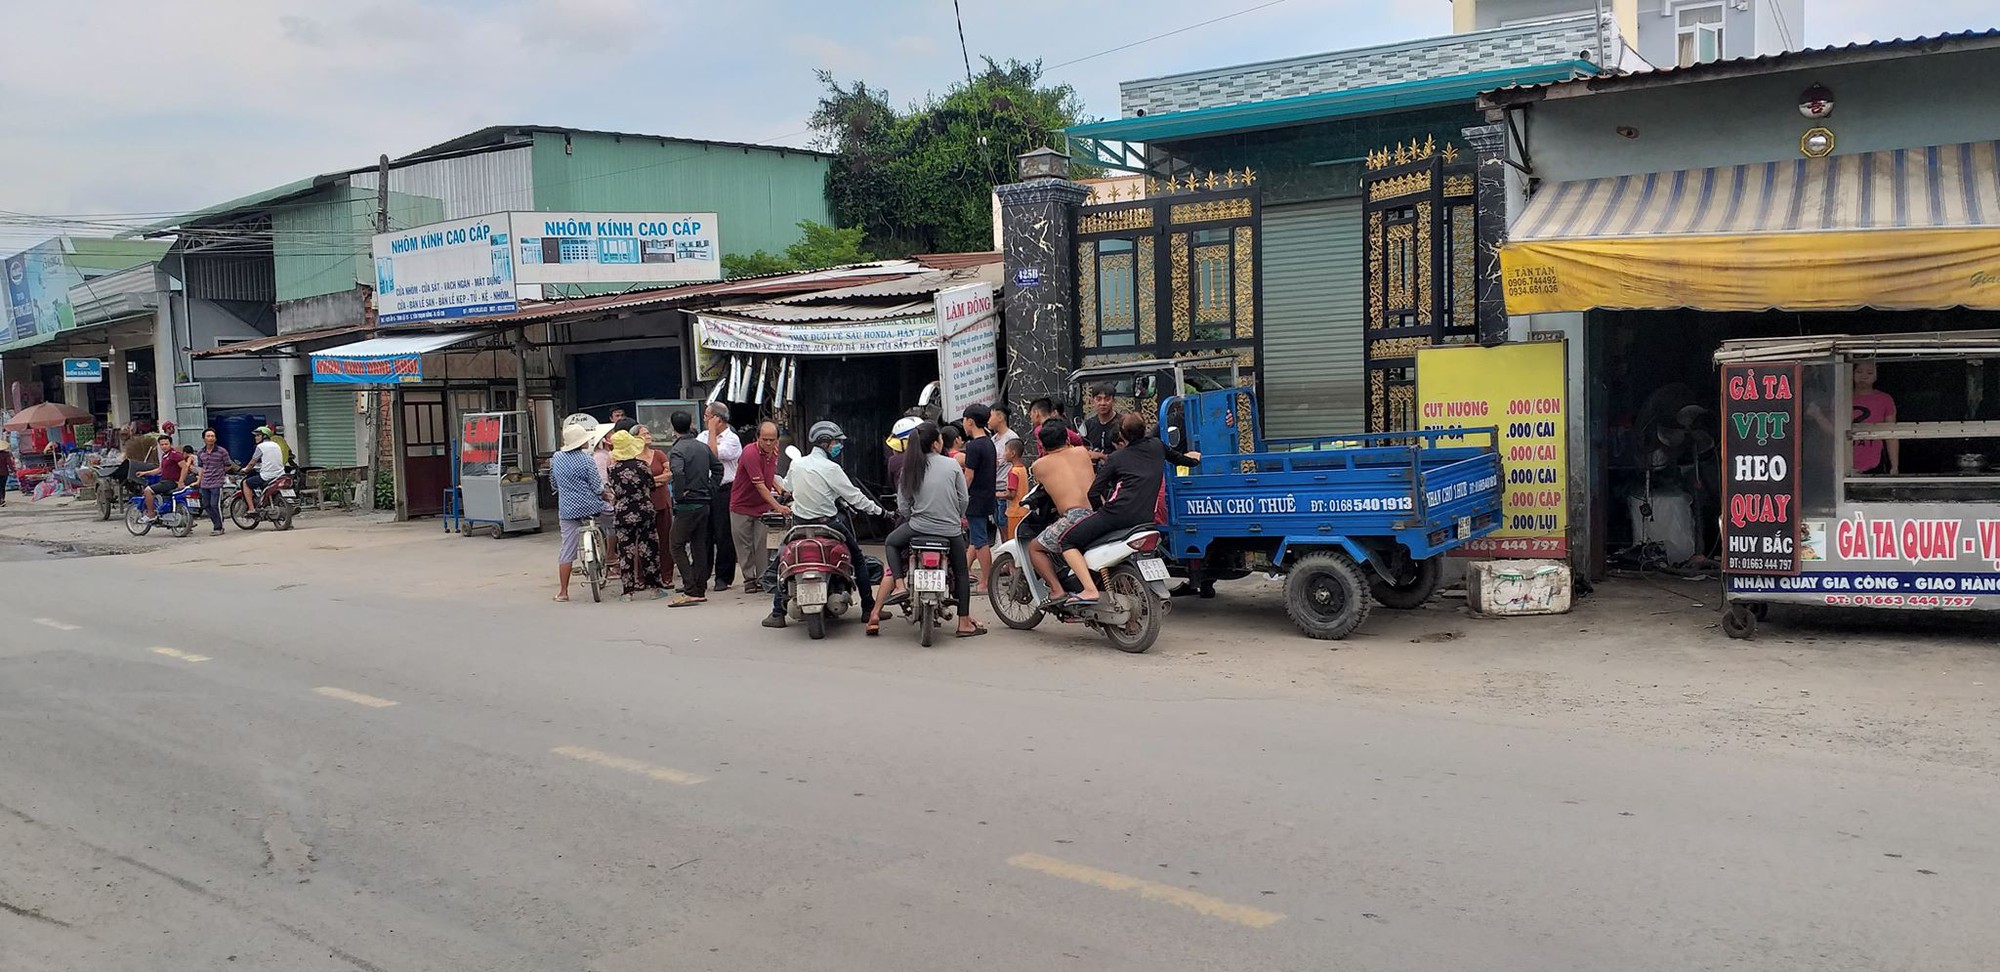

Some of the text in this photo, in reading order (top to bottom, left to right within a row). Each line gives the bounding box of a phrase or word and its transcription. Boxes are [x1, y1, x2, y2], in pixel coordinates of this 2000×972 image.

[545, 217, 701, 236] NHÔM KÍNH CAO CẤP
[392, 220, 490, 254] NHÔM KÍNH CAO CẤP
[1509, 285, 1558, 296] 0934.651.036
[946, 292, 990, 320] LÀM ĐỒNG
[845, 330, 861, 339] SAU
[1730, 369, 1792, 400] GÀ TA
[1506, 398, 1560, 415] .000/CON
[1506, 418, 1554, 439] .000/CÁI
[1732, 412, 1790, 446] VỊT
[1508, 465, 1556, 485] .000/CÁI
[1735, 455, 1787, 481] HEO
[1187, 496, 1222, 514] NHÂN
[1258, 493, 1296, 513] THUÊ
[1311, 500, 1327, 512] ĐT:
[1731, 494, 1791, 528] QUAY
[1510, 514, 1557, 532] .000/LỤI
[1501, 540, 1527, 550] 444
[1532, 540, 1559, 550] 797
[1730, 530, 1793, 554] HUY BẮC
[1836, 511, 1870, 560] GÀ
[1870, 520, 1899, 560] TA
[1901, 518, 1962, 566] QUAY
[1729, 558, 1792, 570] ĐT: 01663 444 797
[1734, 574, 1775, 591] NHẬN
[1780, 577, 1818, 589] QUAY
[1822, 577, 1850, 589] GIA
[1854, 575, 1899, 589] CÔNG
[1915, 578, 1956, 590] GIAO
[1826, 595, 1976, 606] ĐT: 01663 444 797
